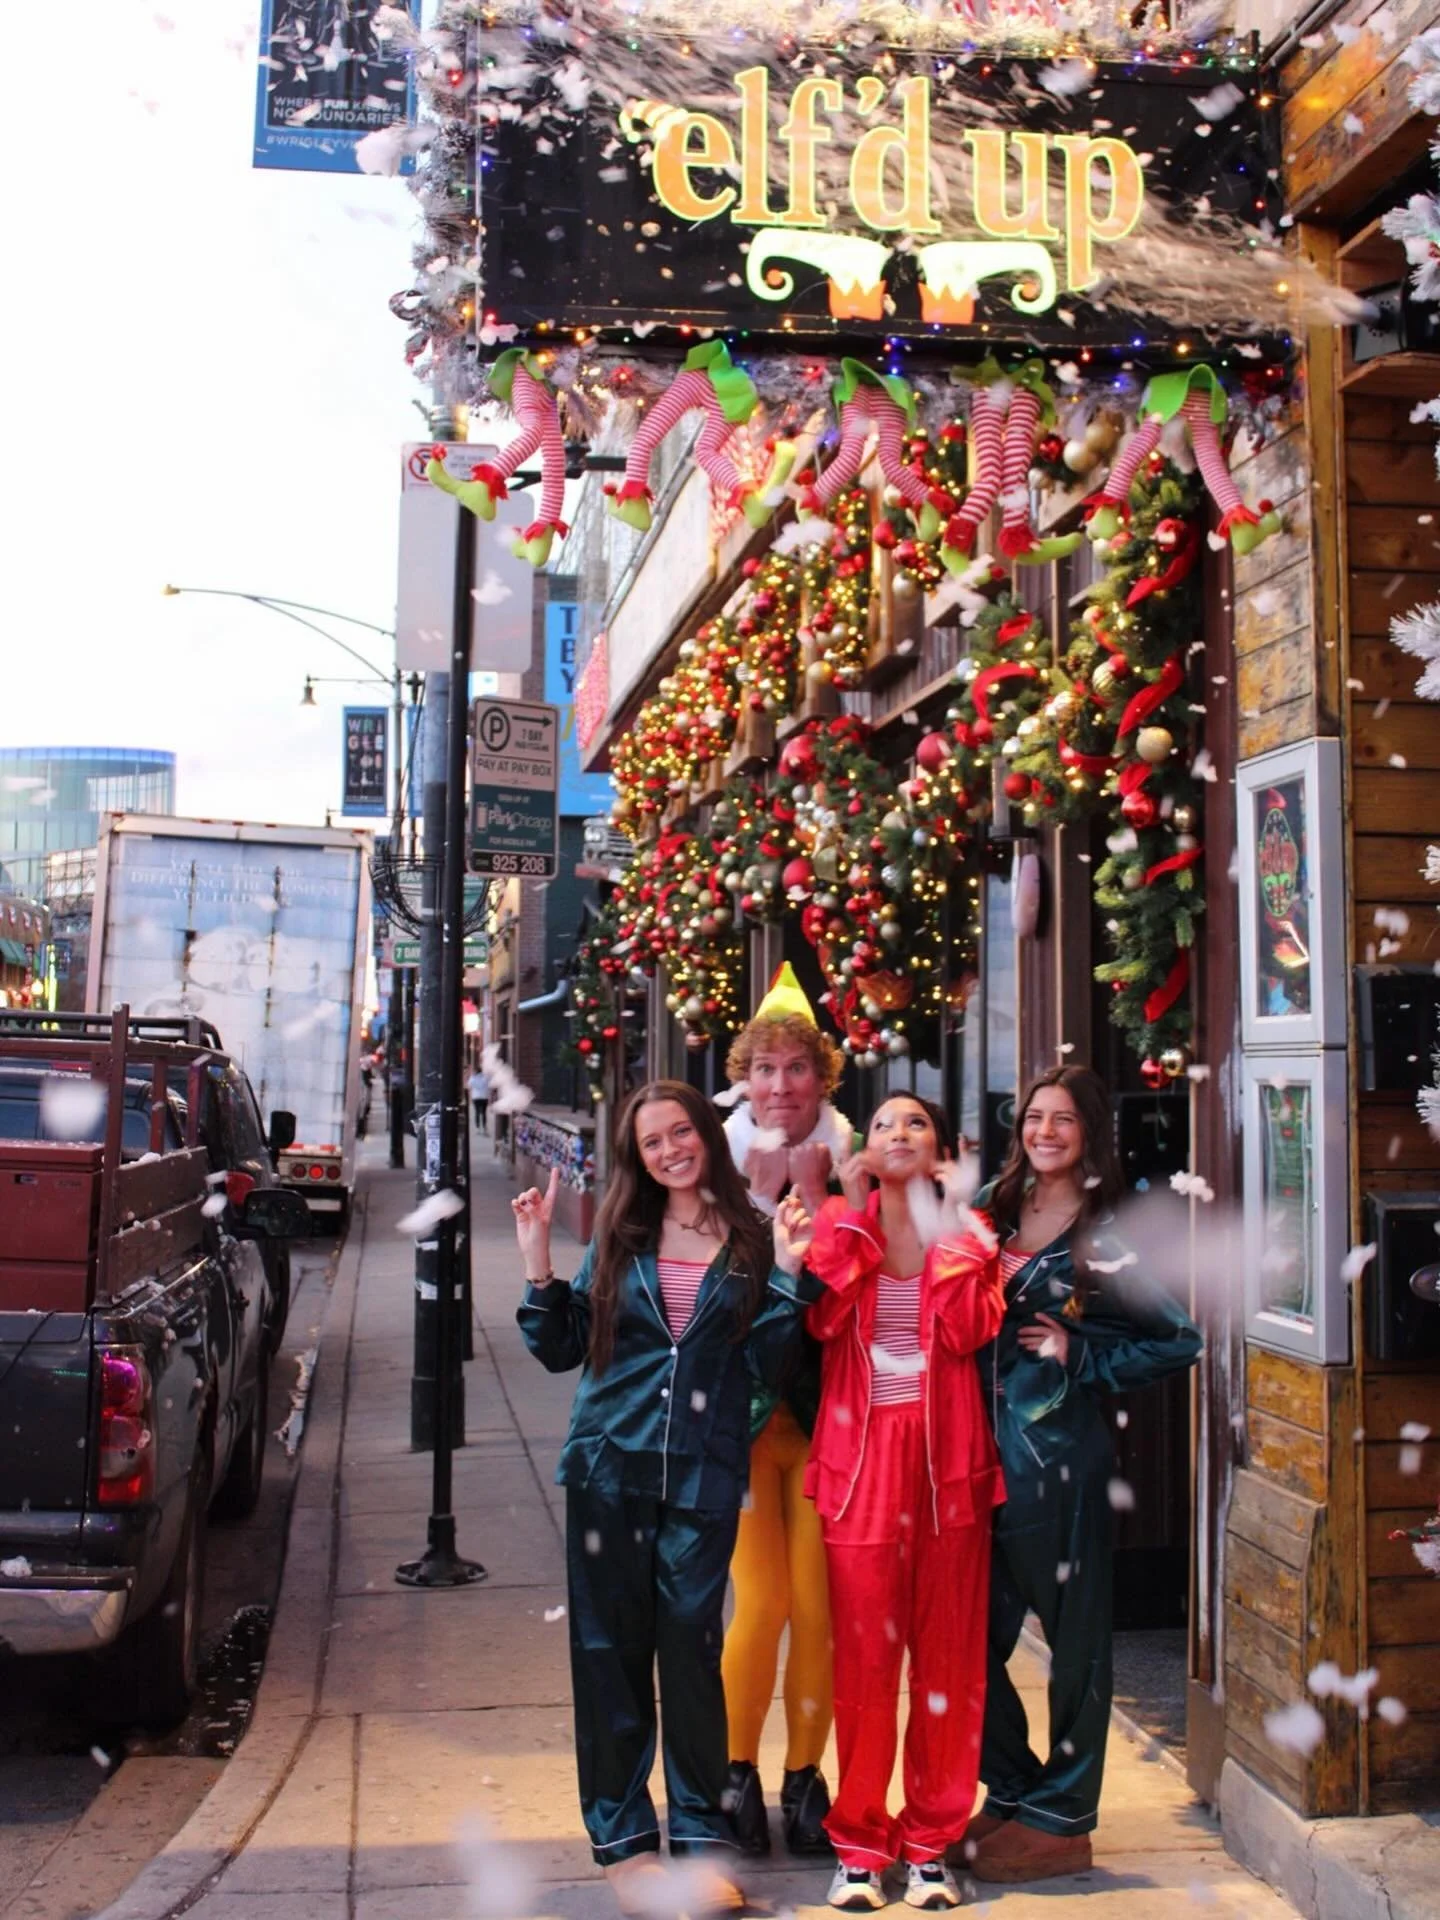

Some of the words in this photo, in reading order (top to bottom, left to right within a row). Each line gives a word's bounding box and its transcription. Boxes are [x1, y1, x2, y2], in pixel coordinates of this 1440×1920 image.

[323, 99, 349, 110] FUN
[273, 107, 295, 120] NO
[305, 109, 400, 125] OUNDARIES
[652, 66, 941, 233] elf'd
[964, 129, 1144, 291] up
[477, 757, 496, 771] PAY
[497, 760, 509, 772] AT
[511, 761, 529, 774] PAY
[531, 763, 552, 777] BOX
[492, 854, 518, 873] 925
[520, 856, 545, 874] 208
